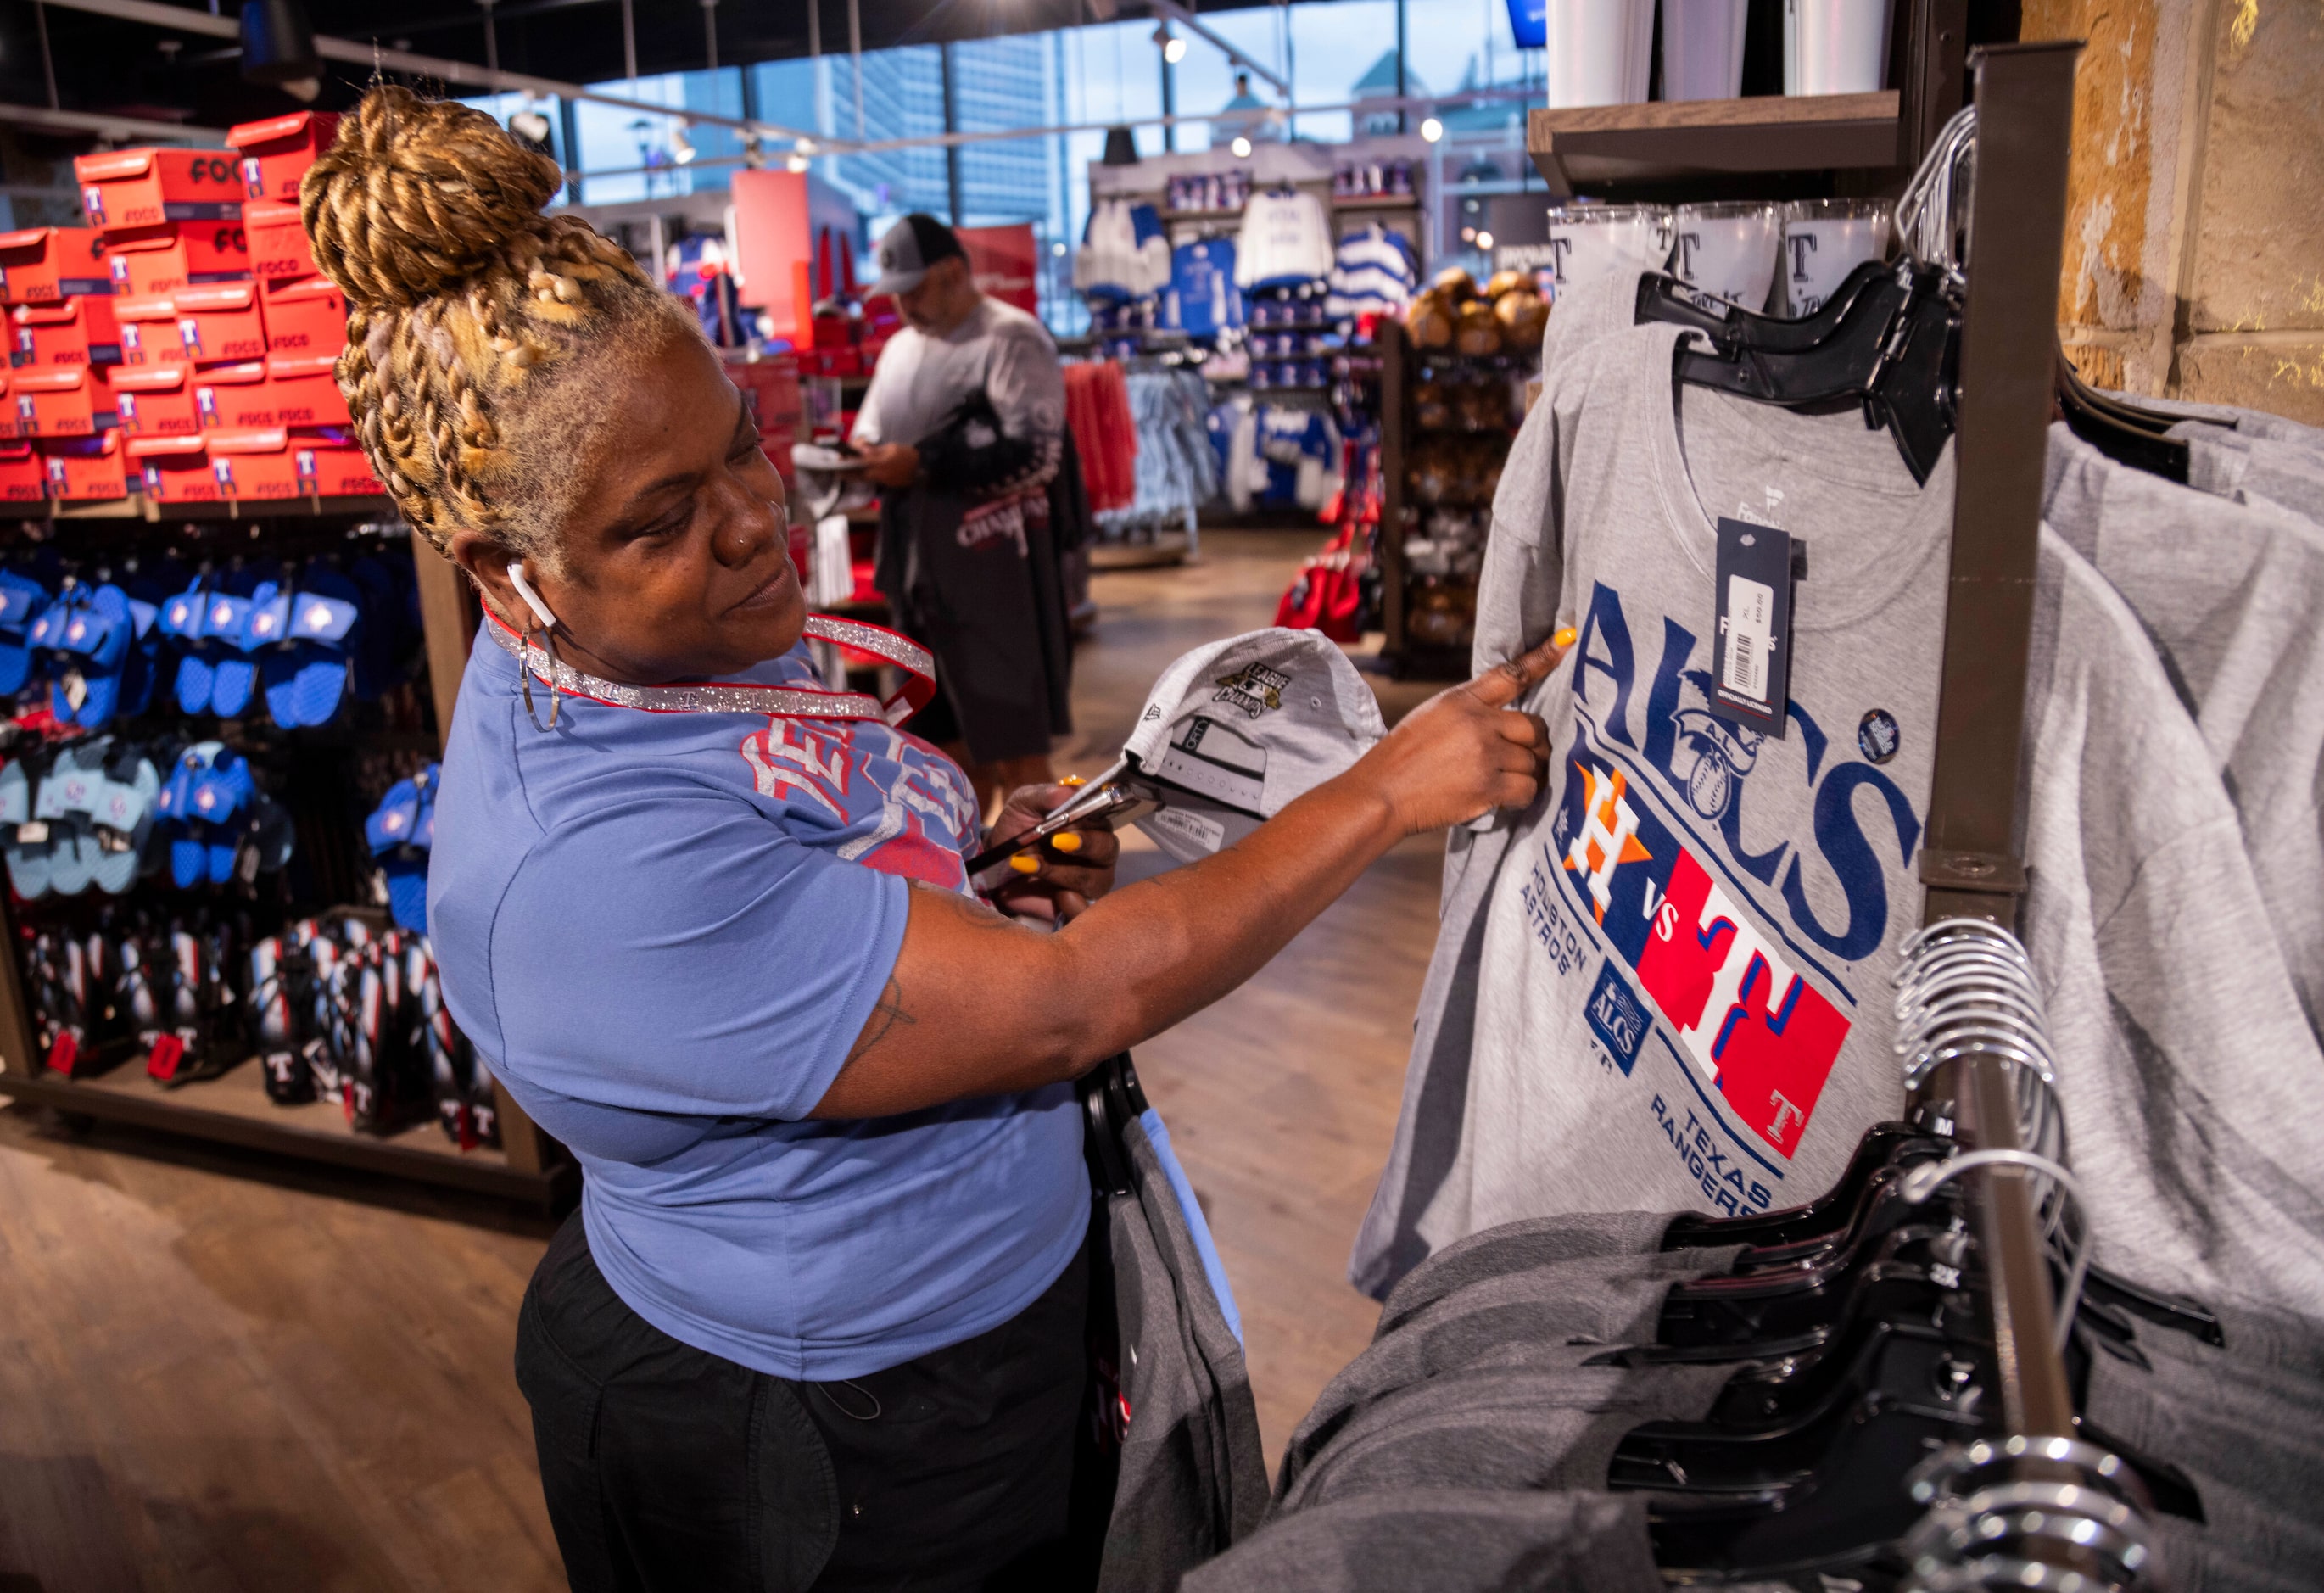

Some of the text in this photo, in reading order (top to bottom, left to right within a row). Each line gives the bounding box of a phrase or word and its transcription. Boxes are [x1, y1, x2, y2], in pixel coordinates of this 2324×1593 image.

[1788, 233, 1817, 282] T
[1572, 579, 1920, 961] ALCS
[1519, 884, 1571, 976] ASTROS
[1530, 859, 1588, 973] HOUSTON
[1643, 876, 1679, 942] VS
[1592, 992, 1636, 1055] ALCS
[1679, 880, 1805, 1091] T
[1685, 1107, 1773, 1210] TEXAS
[1766, 1088, 1805, 1144] T
